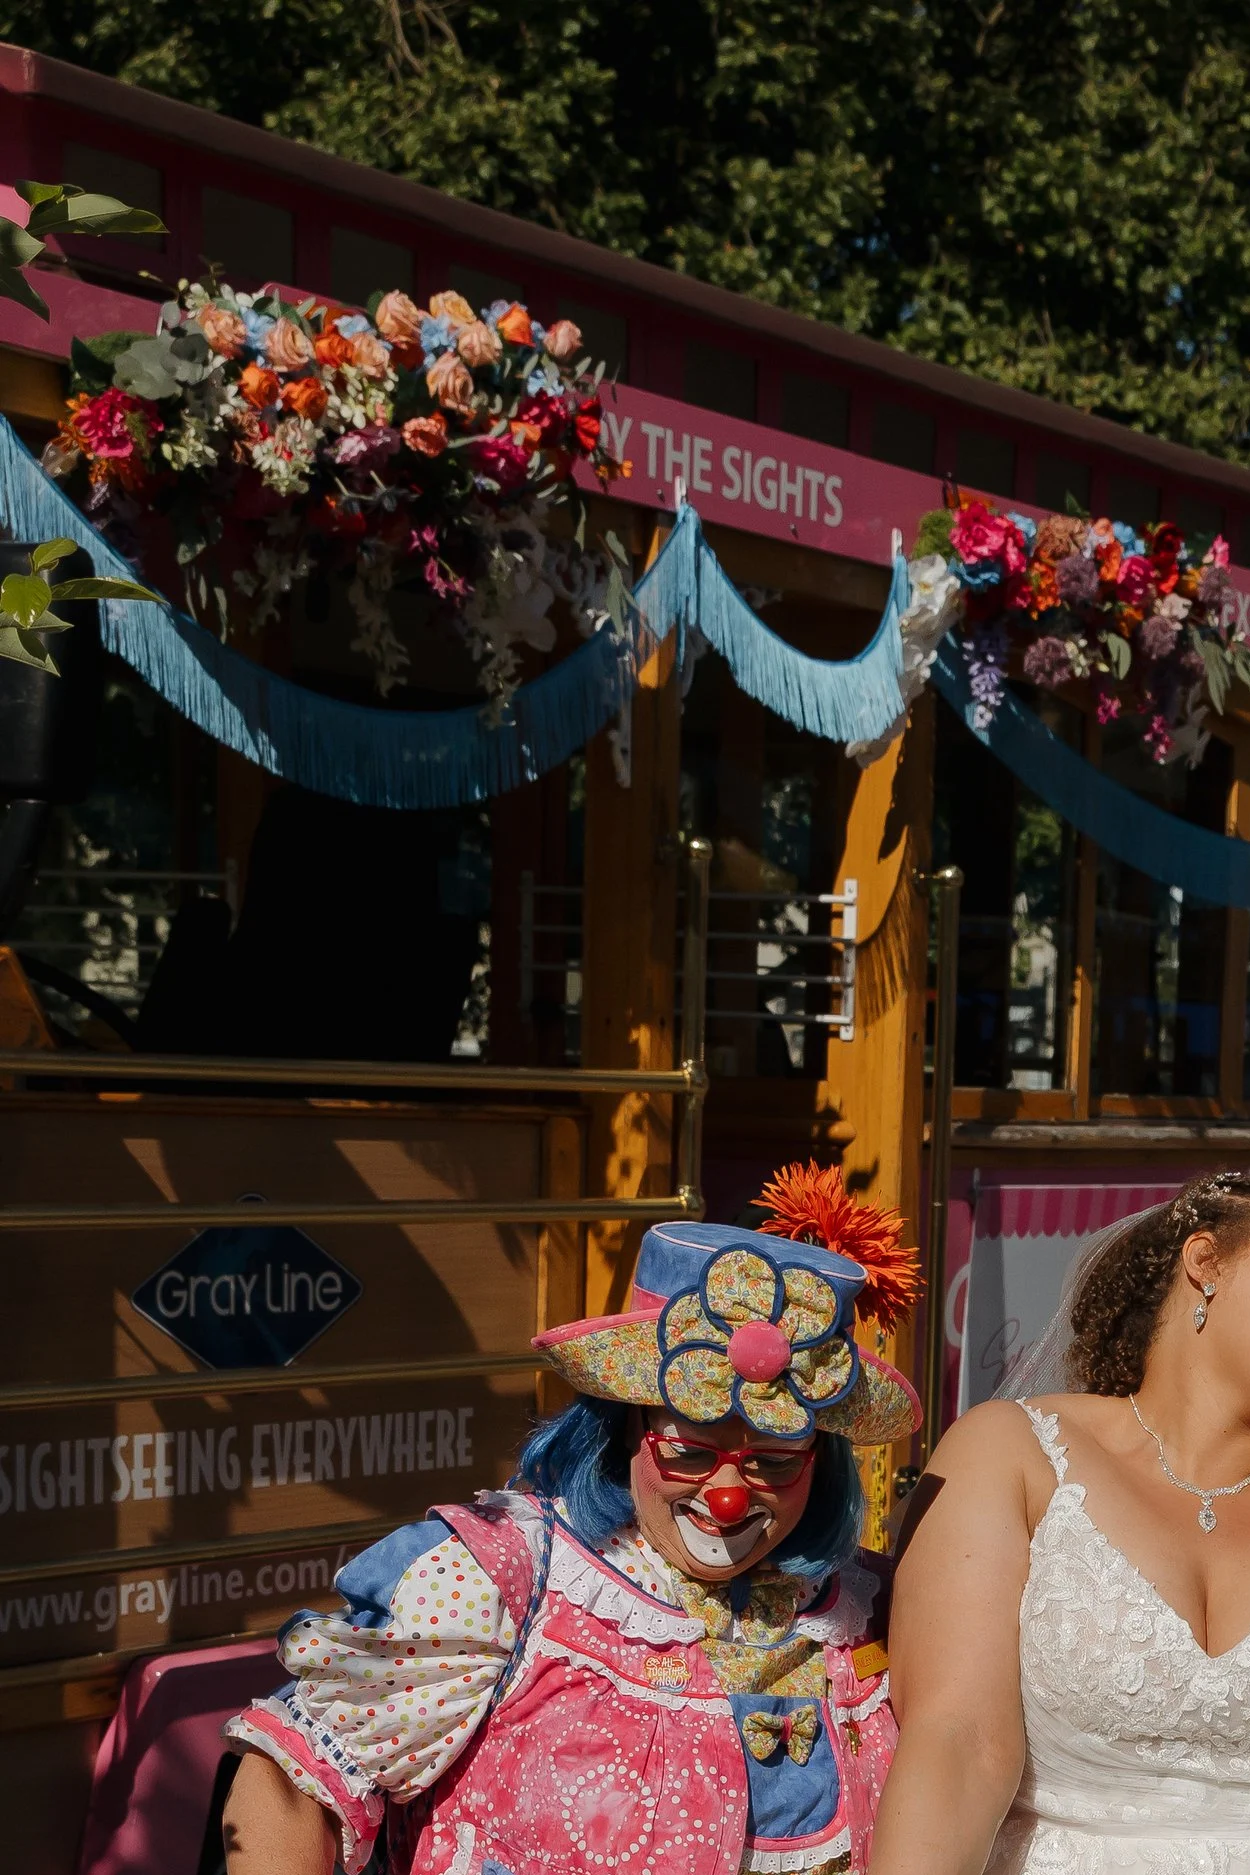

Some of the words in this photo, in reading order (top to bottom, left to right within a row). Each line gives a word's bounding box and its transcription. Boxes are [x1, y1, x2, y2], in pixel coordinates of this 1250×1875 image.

[641, 421, 713, 494] THE
[721, 446, 843, 527] SIGHTS
[155, 1269, 259, 1319] Gray
[248, 1406, 475, 1490] EVERYWHERE
